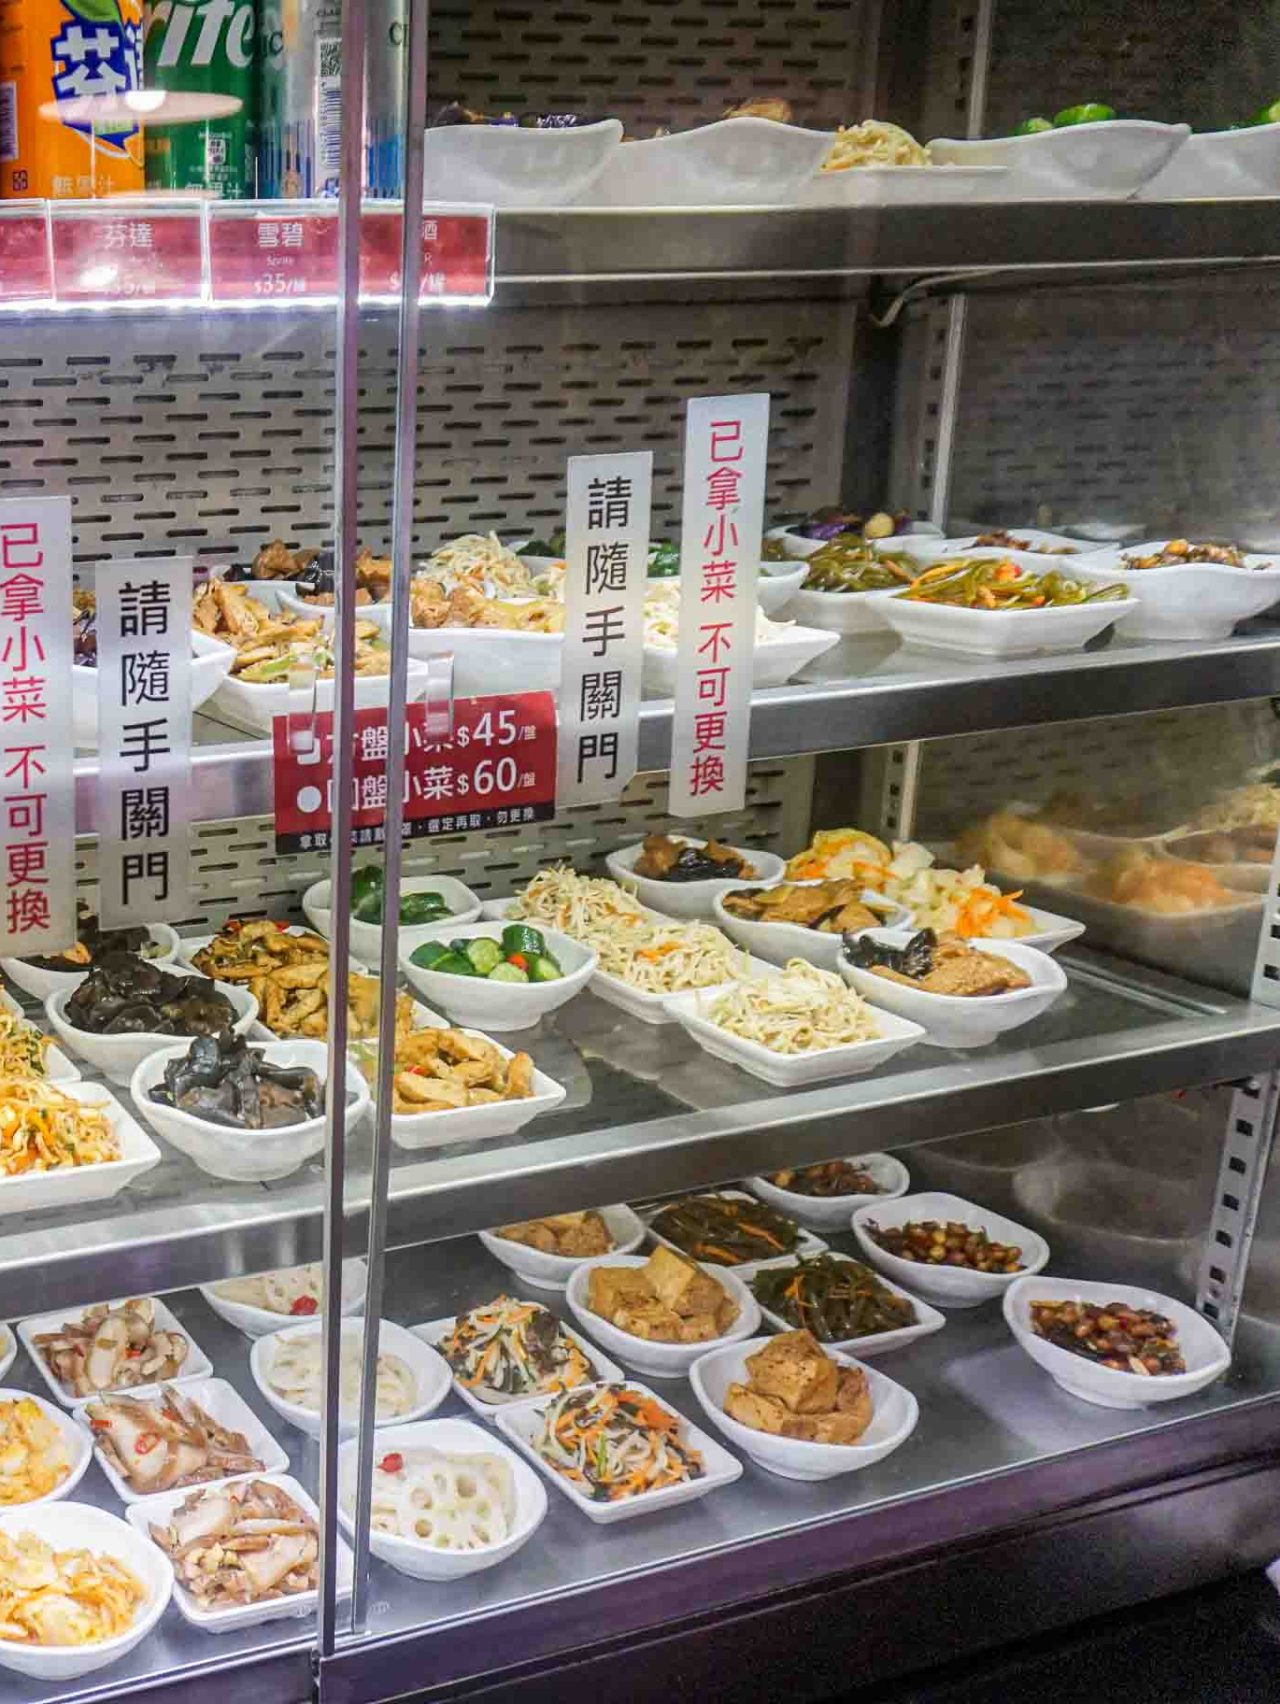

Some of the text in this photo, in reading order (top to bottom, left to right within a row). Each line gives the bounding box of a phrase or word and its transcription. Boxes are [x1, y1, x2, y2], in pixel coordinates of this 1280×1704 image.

[101, 217, 153, 250] 芬達
[258, 222, 304, 248] 雪碧
[0, 521, 52, 934] 已拿小菜 不可更換
[118, 580, 171, 906] 請隨手關門
[577, 476, 632, 783] 請隨手關門
[690, 420, 745, 797] 已拿小菜 不可更換
